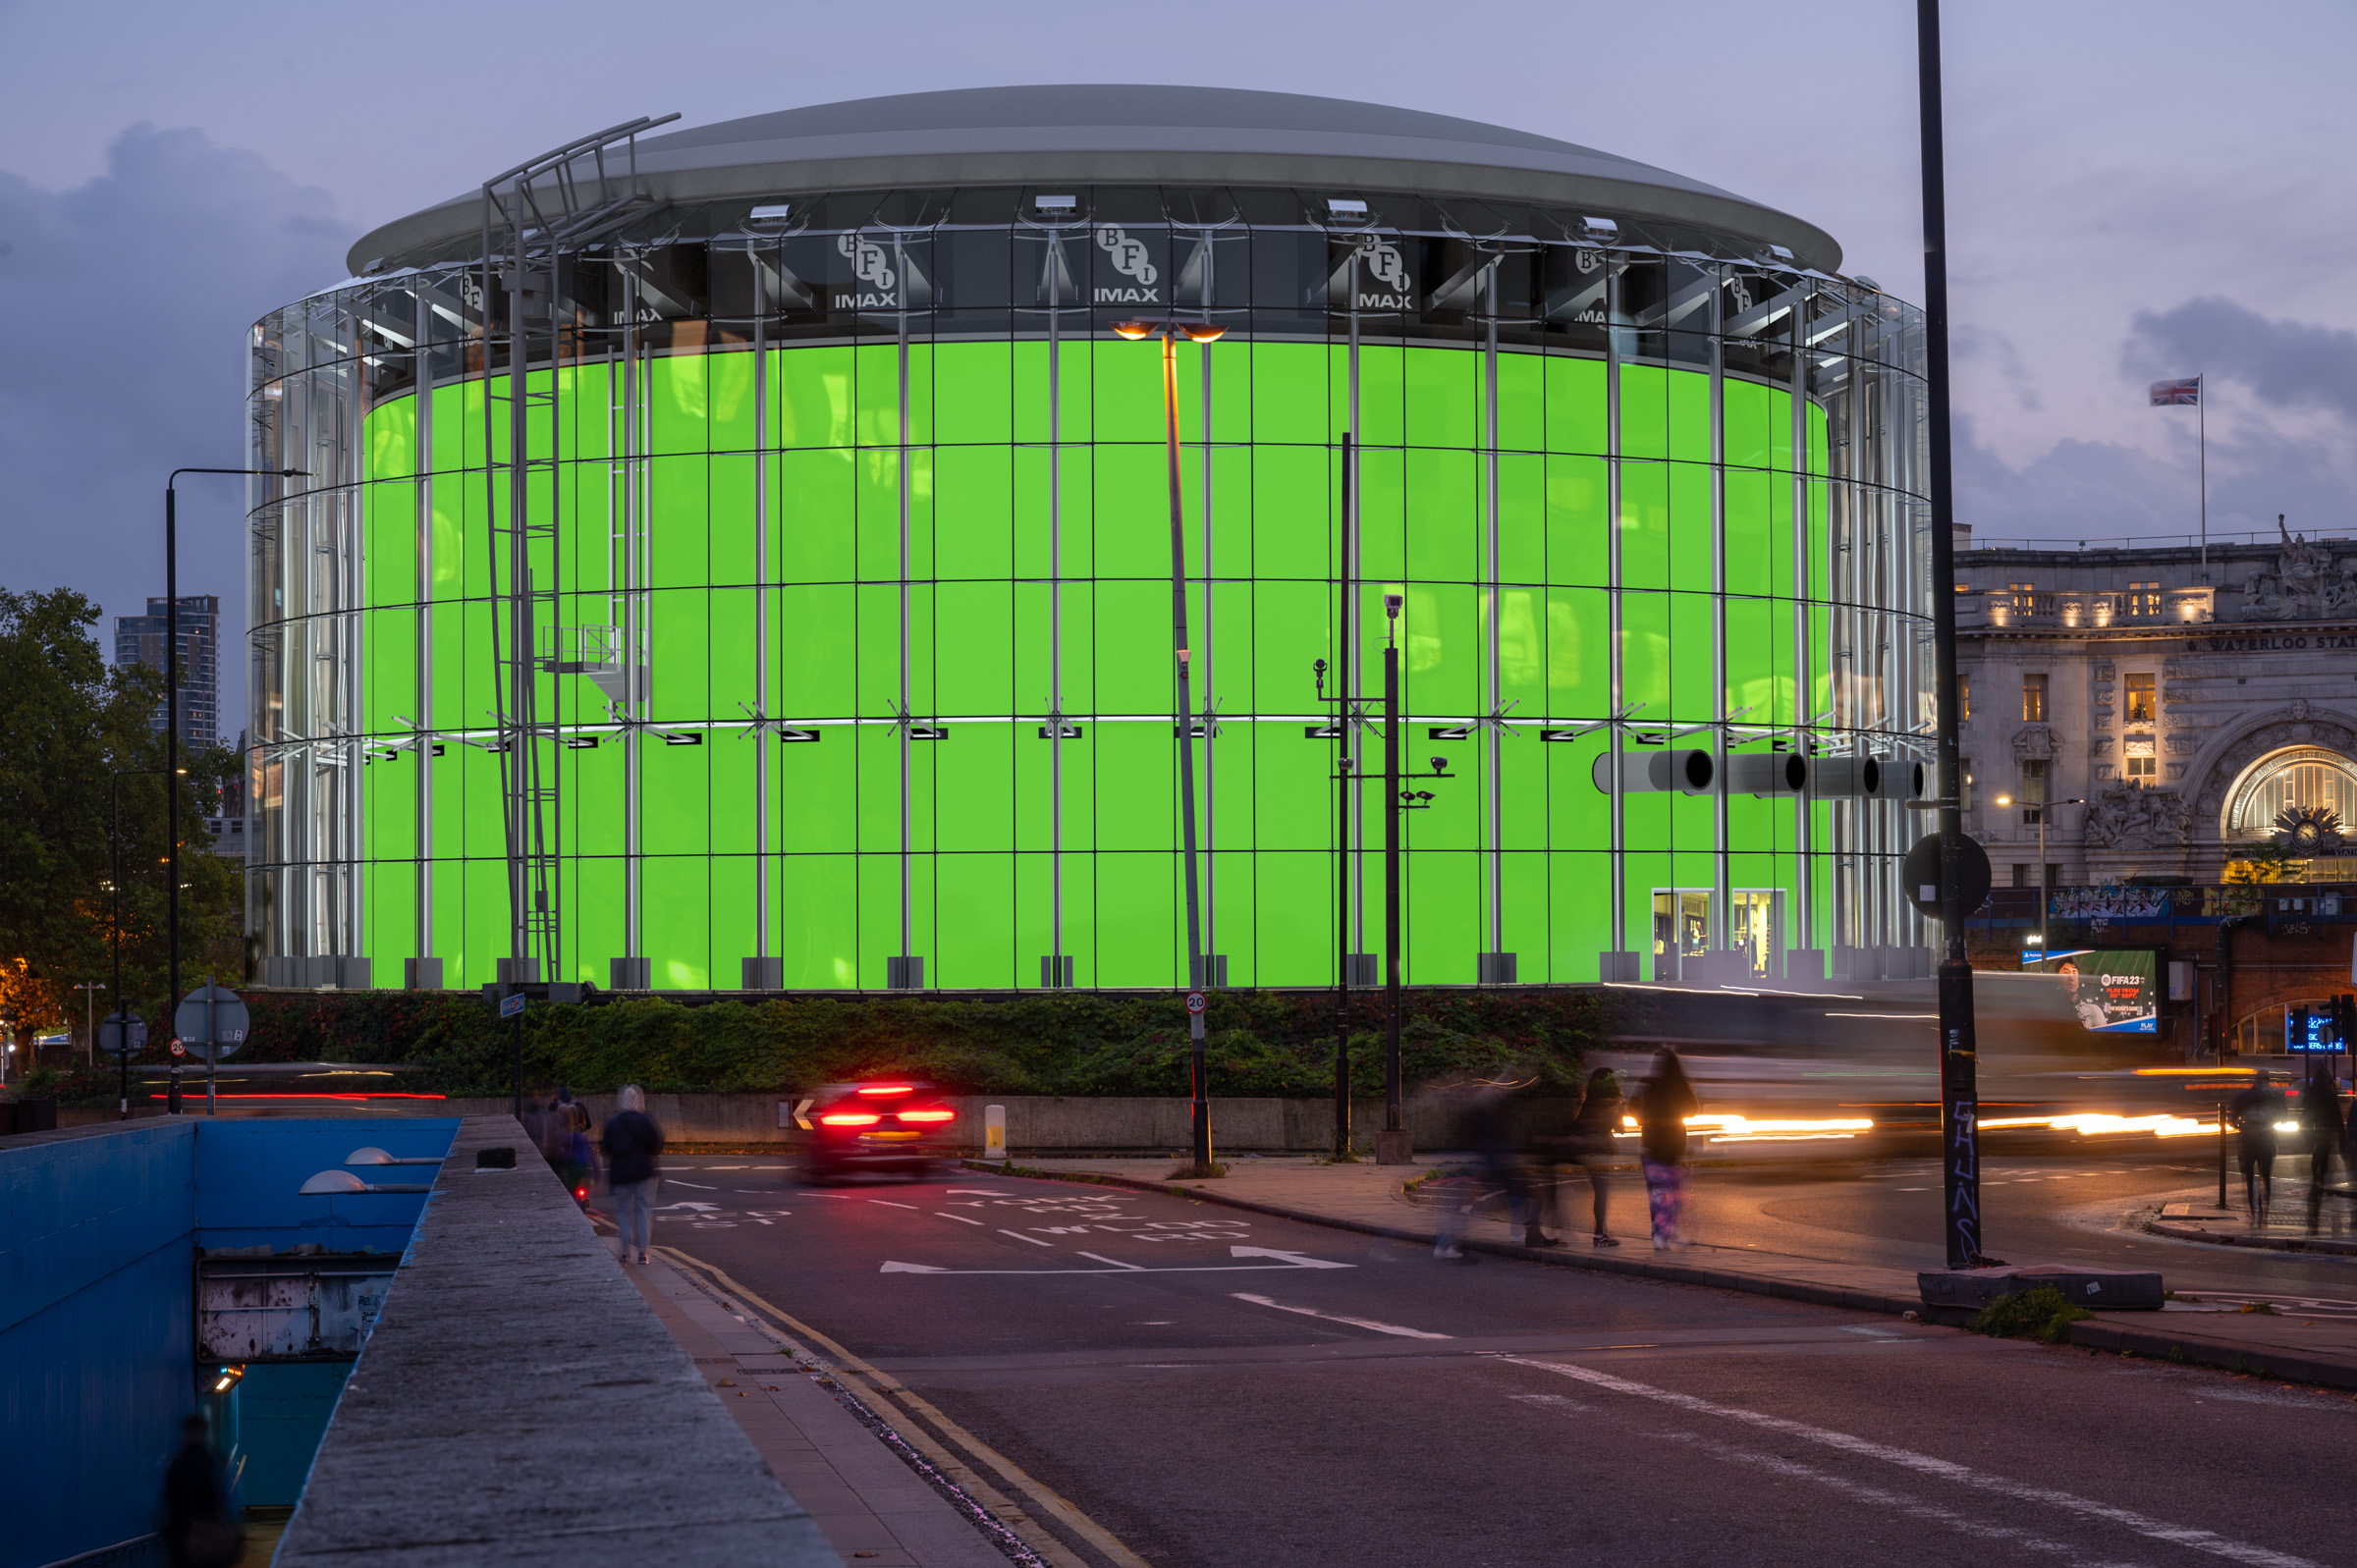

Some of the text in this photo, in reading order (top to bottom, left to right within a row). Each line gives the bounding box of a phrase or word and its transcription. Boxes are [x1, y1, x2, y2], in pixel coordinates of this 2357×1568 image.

[1102, 226, 1150, 282] BFI
[835, 293, 897, 309] IMAX
[1094, 288, 1159, 302] IMAX
[1359, 293, 1412, 309] MAX
[2210, 636, 2307, 652] WATERLOO
[2334, 848, 2357, 857] STATI
[2111, 976, 2129, 985] FIFA
[1188, 998, 1204, 1007] 20
[944, 1195, 1137, 1208] YORK
[1021, 1204, 1121, 1213] RD
[1131, 1231, 1251, 1242] RD
